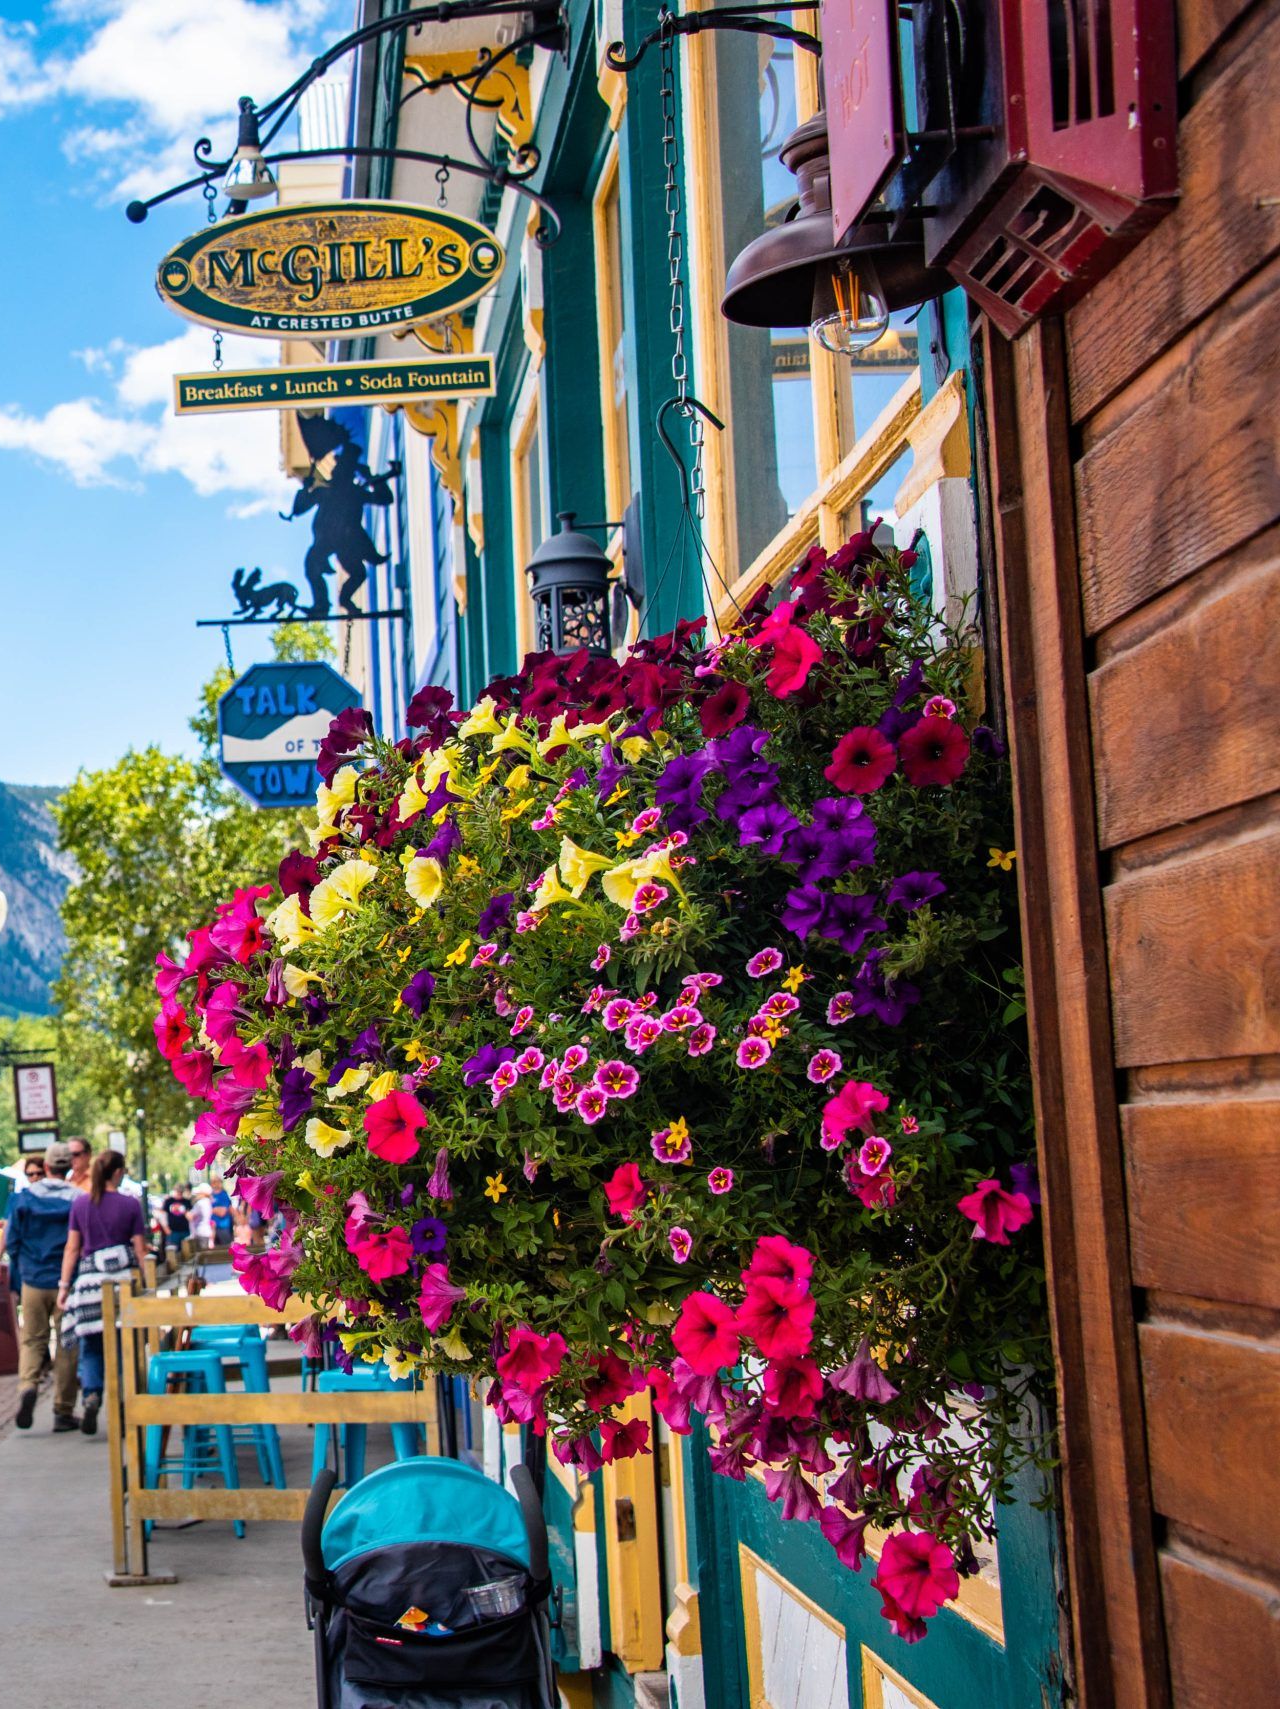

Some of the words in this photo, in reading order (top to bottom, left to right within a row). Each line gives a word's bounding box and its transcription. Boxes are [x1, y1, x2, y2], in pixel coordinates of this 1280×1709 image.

[206, 237, 463, 302] McGILL'S
[250, 315, 272, 328] AT
[277, 316, 353, 330] CRESTED
[358, 305, 414, 327] BUTTE
[185, 382, 264, 402] Breakfast
[284, 376, 338, 395] Lunch
[360, 372, 403, 390] Soda
[407, 368, 485, 388] Fountain
[235, 684, 318, 716] TALK
[284, 739, 305, 753] OF
